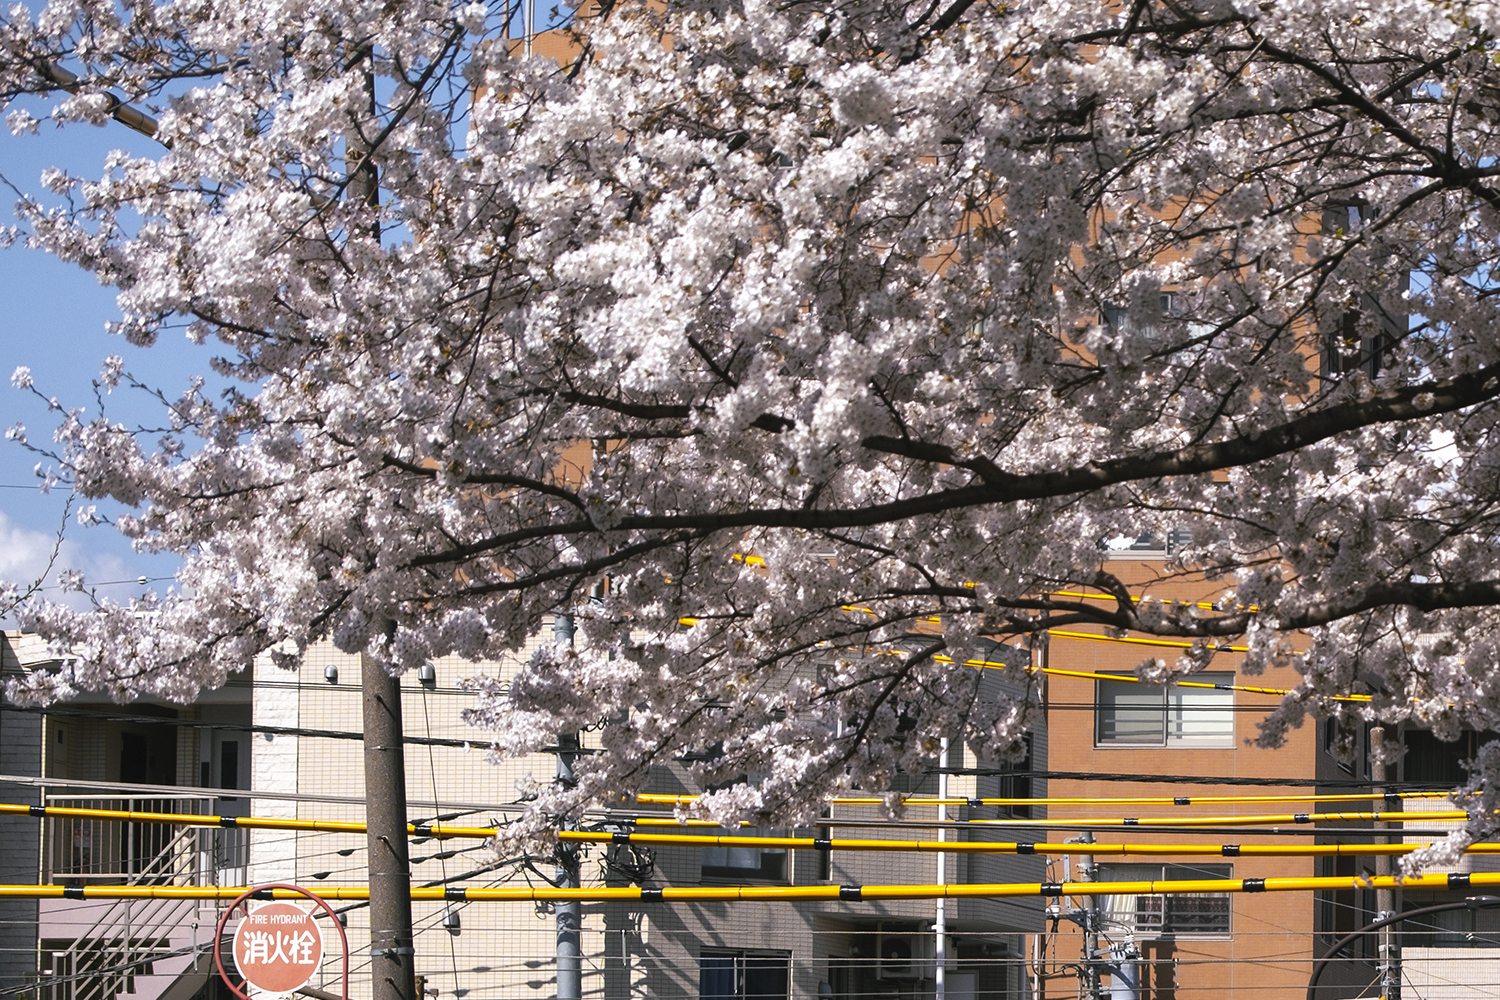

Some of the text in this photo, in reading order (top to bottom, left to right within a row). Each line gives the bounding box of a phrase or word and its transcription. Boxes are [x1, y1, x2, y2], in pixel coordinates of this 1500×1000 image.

[250, 914, 308, 925] FIRE HYDRANT
[243, 930, 316, 965] 消火栓
